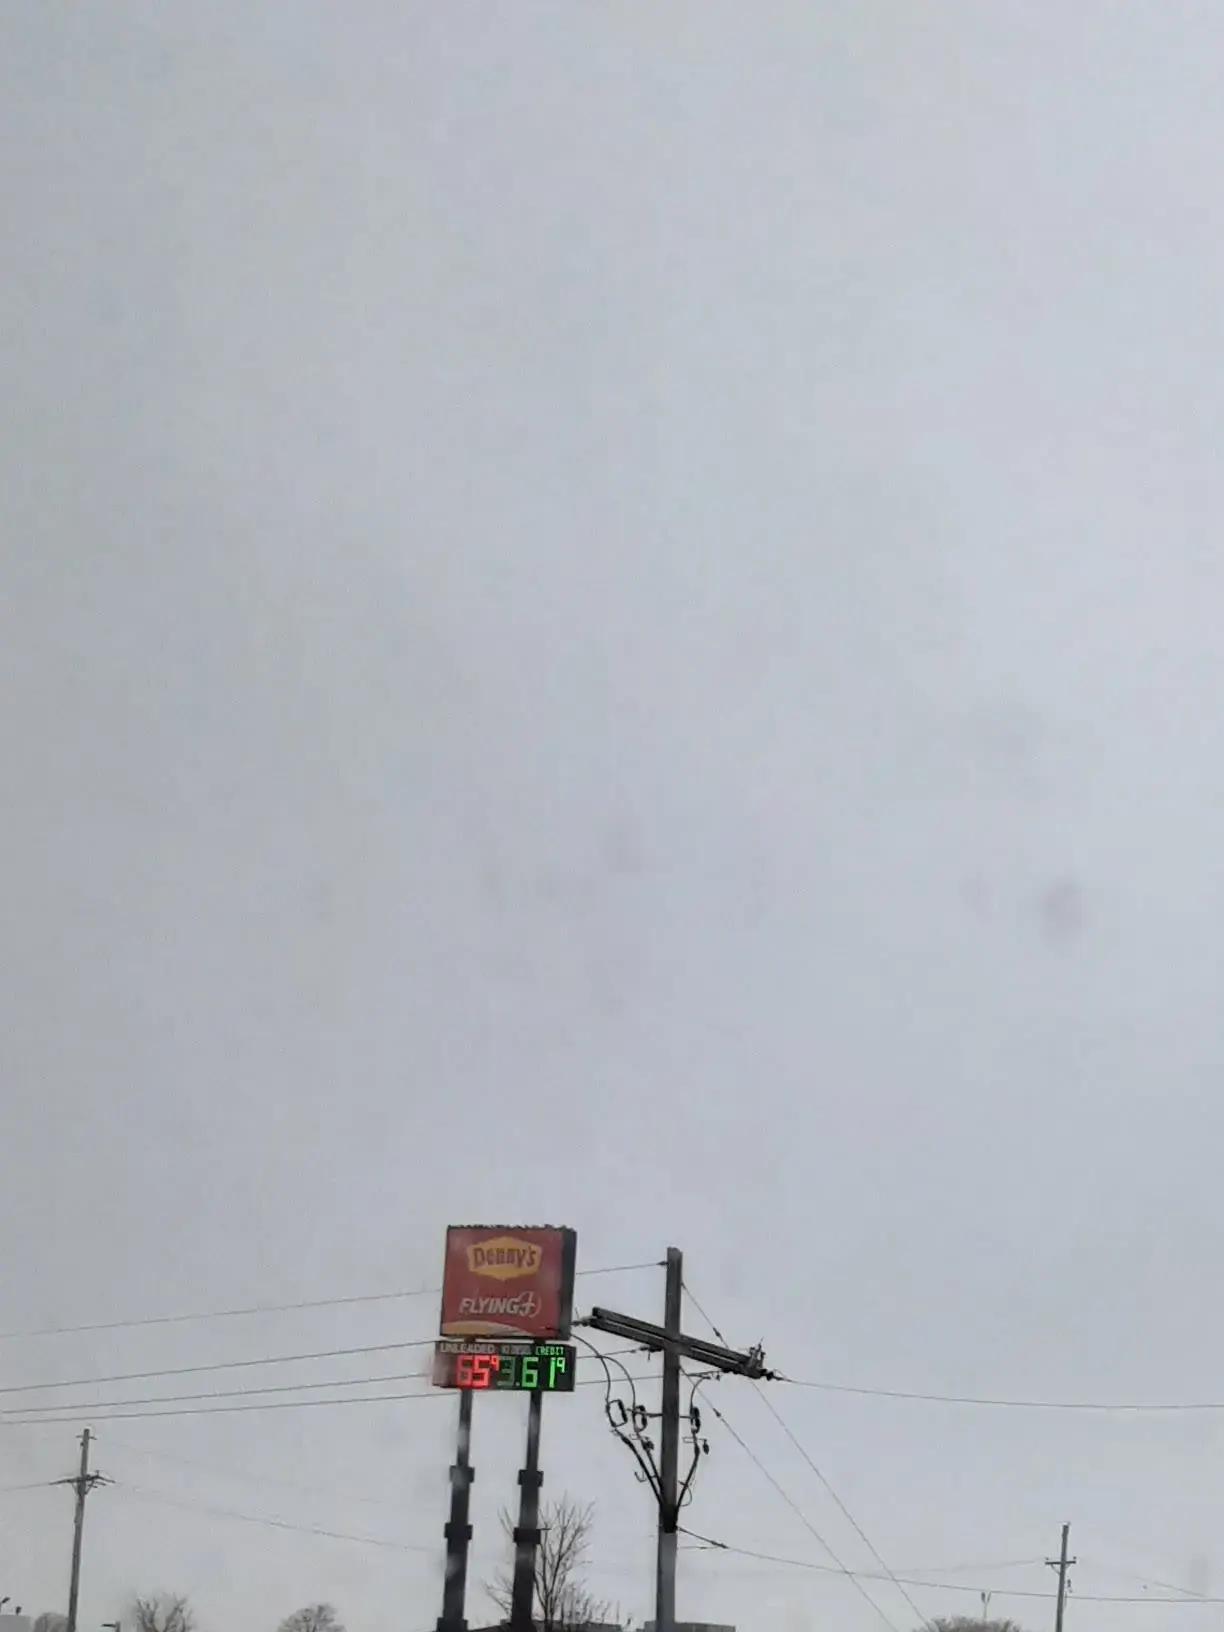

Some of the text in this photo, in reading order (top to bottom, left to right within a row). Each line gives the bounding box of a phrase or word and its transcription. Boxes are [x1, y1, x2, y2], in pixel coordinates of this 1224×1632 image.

[473, 1246, 537, 1269] Denny's
[459, 1297, 519, 1314] FLYING
[440, 1343, 496, 1354] UNLEADED
[536, 1346, 565, 1356] CREDIT
